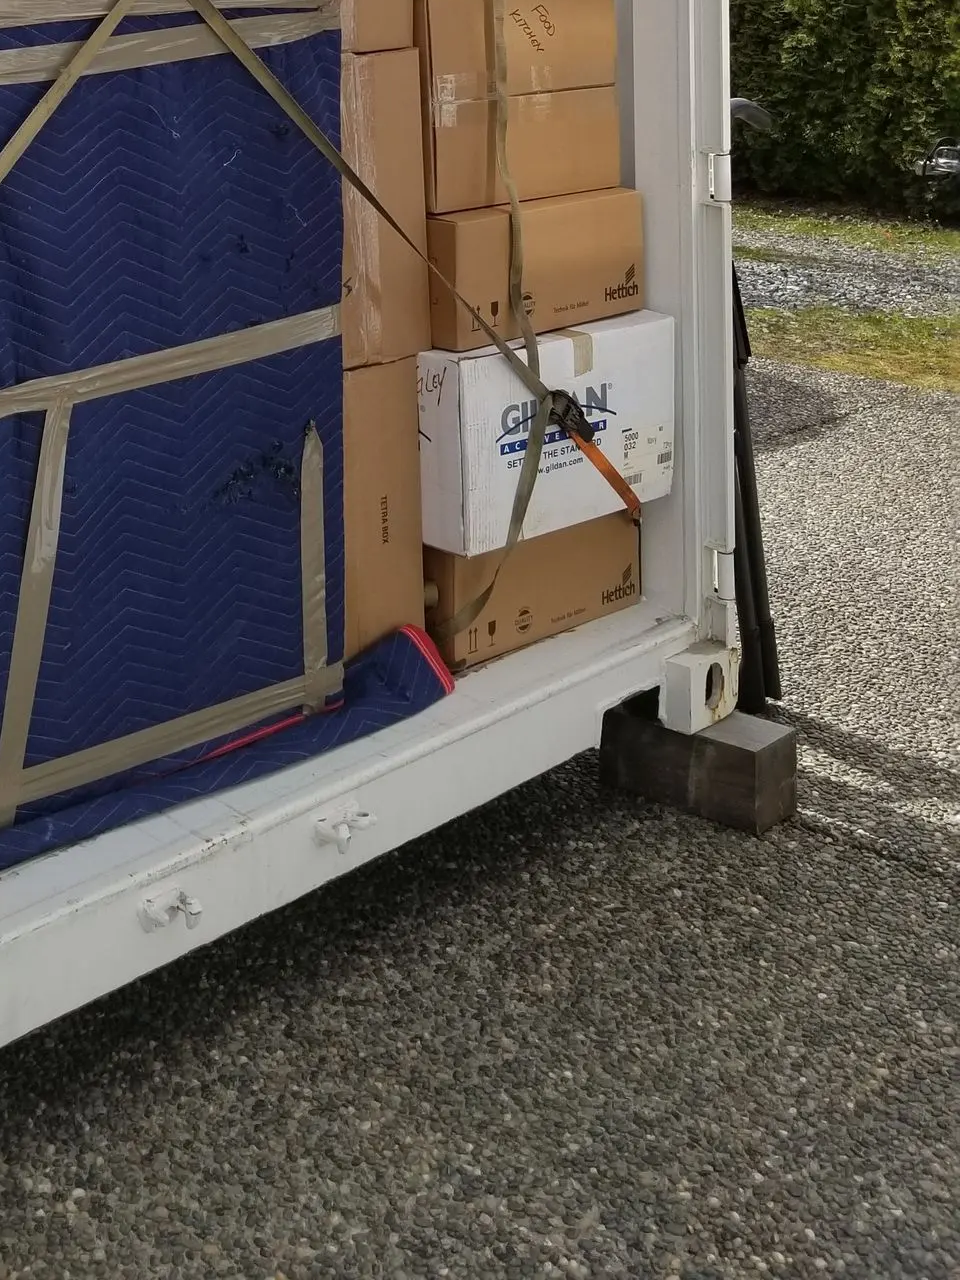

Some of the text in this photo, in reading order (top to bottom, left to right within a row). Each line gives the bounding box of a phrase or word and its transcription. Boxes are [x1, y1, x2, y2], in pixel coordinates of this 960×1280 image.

[530, 4, 556, 37] FOOD
[605, 280, 639, 302] Hettich
[543, 448, 559, 460] THE
[624, 441, 637, 451] 032
[380, 495, 389, 545] TETRA BOX
[601, 580, 636, 606] Hettich
